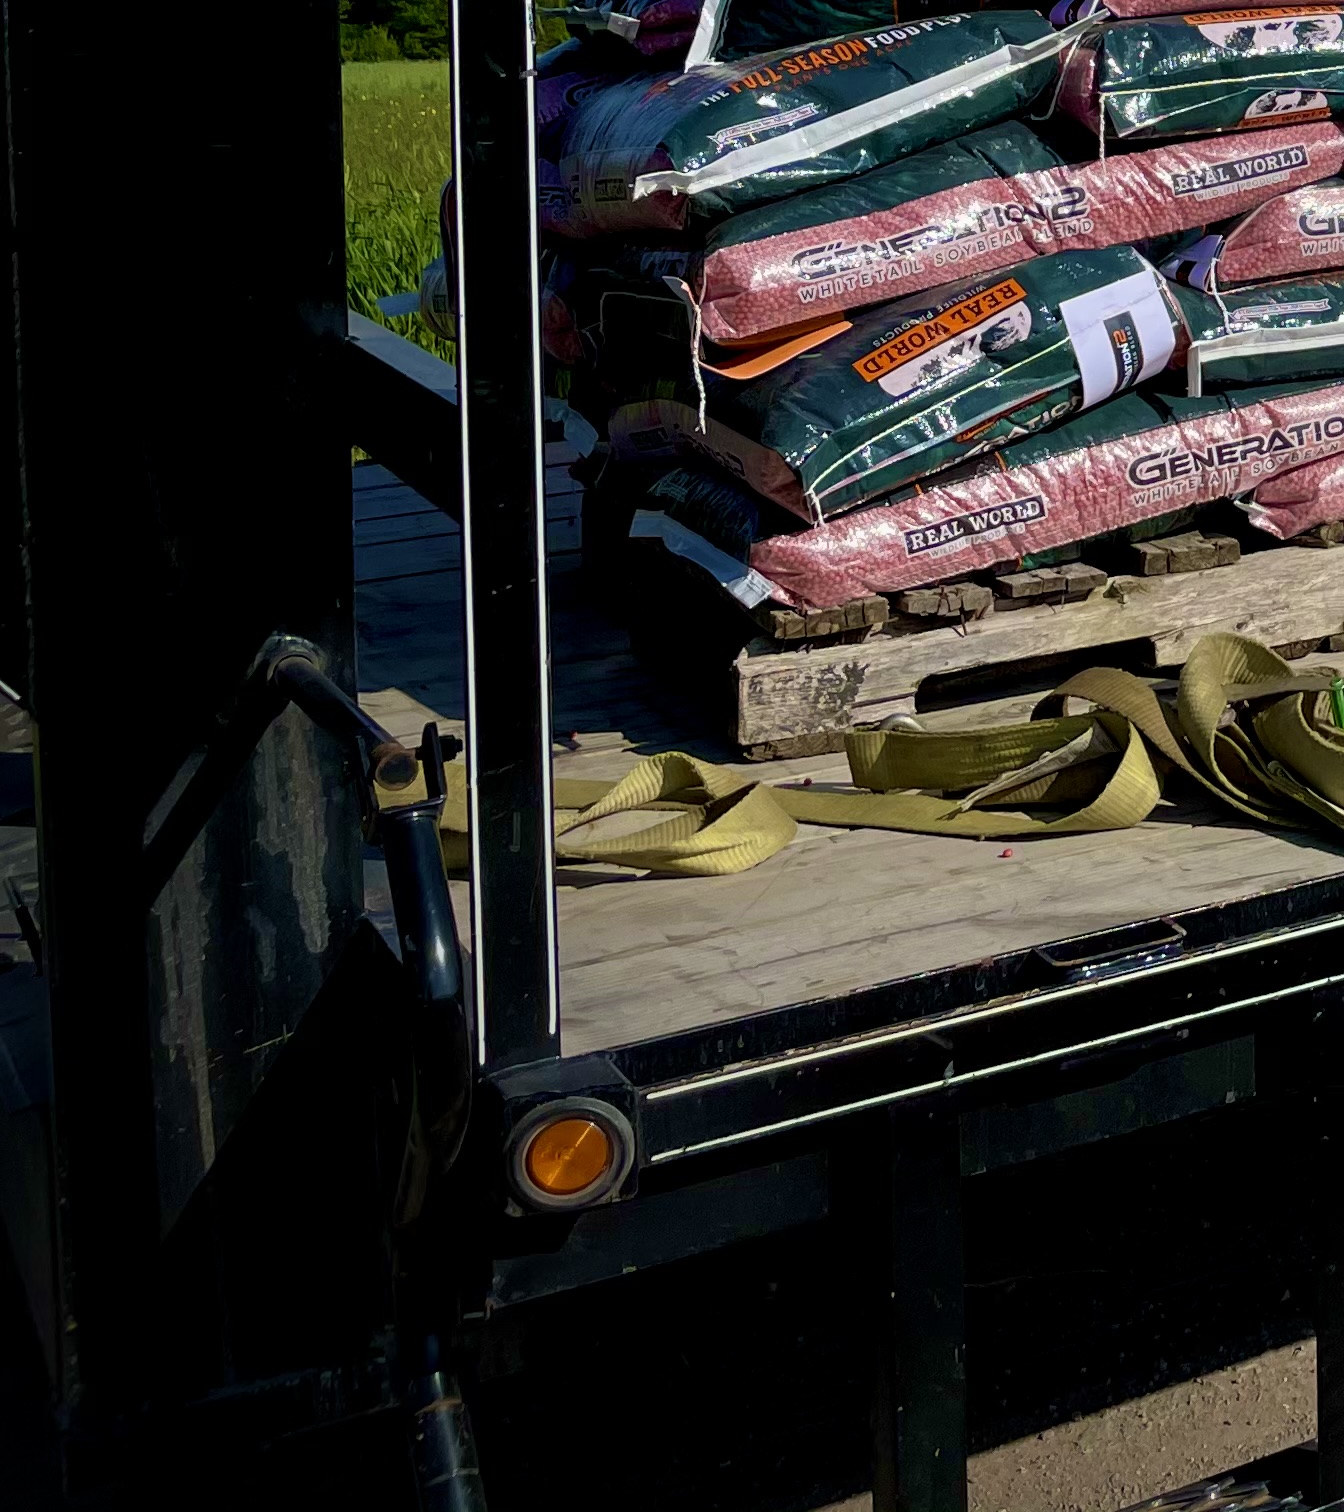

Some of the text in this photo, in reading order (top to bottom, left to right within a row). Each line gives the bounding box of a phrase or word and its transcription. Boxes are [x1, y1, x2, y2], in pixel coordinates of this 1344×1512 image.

[700, 89, 730, 107] THE
[729, 37, 868, 94] FULL-SEASON
[864, 25, 921, 49] FOOD
[1177, 148, 1304, 192] REAL WORLD
[800, 262, 924, 303] WHITETAIL
[863, 283, 1019, 375] REAL WORLD
[872, 310, 934, 348] PRODUCTS
[911, 500, 1041, 550] REAL WORLD
